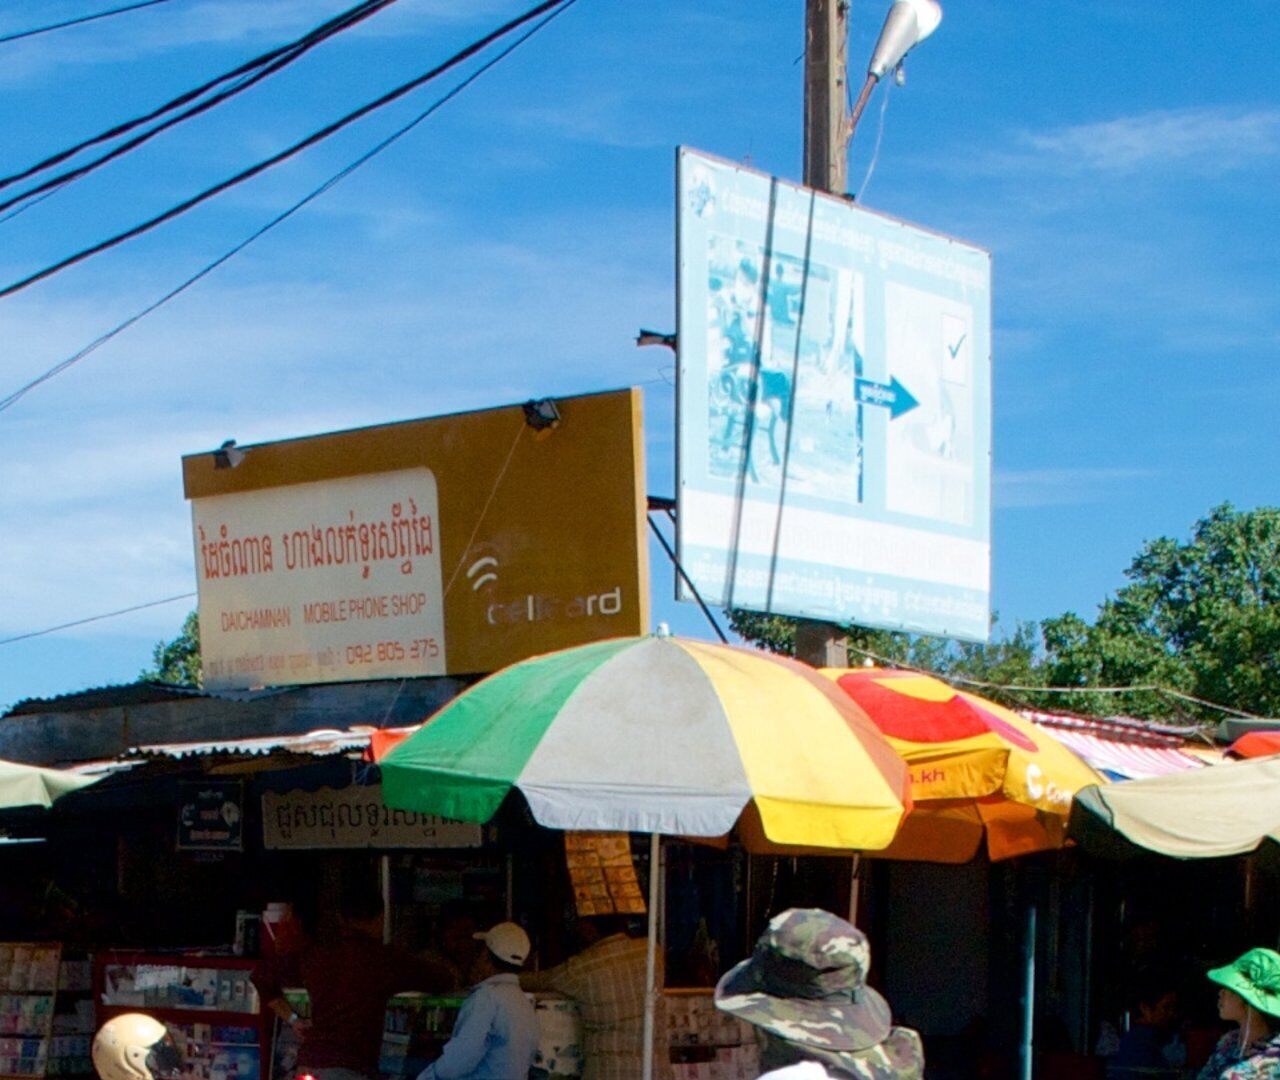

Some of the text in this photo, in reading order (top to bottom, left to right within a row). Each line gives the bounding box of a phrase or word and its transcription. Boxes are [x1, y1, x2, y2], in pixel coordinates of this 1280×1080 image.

[222, 592, 427, 632] DAICHAMNAN MOBILE PHONE SHOP
[346, 645, 372, 665] 092
[376, 641, 405, 661] 805
[409, 638, 440, 660] 375
